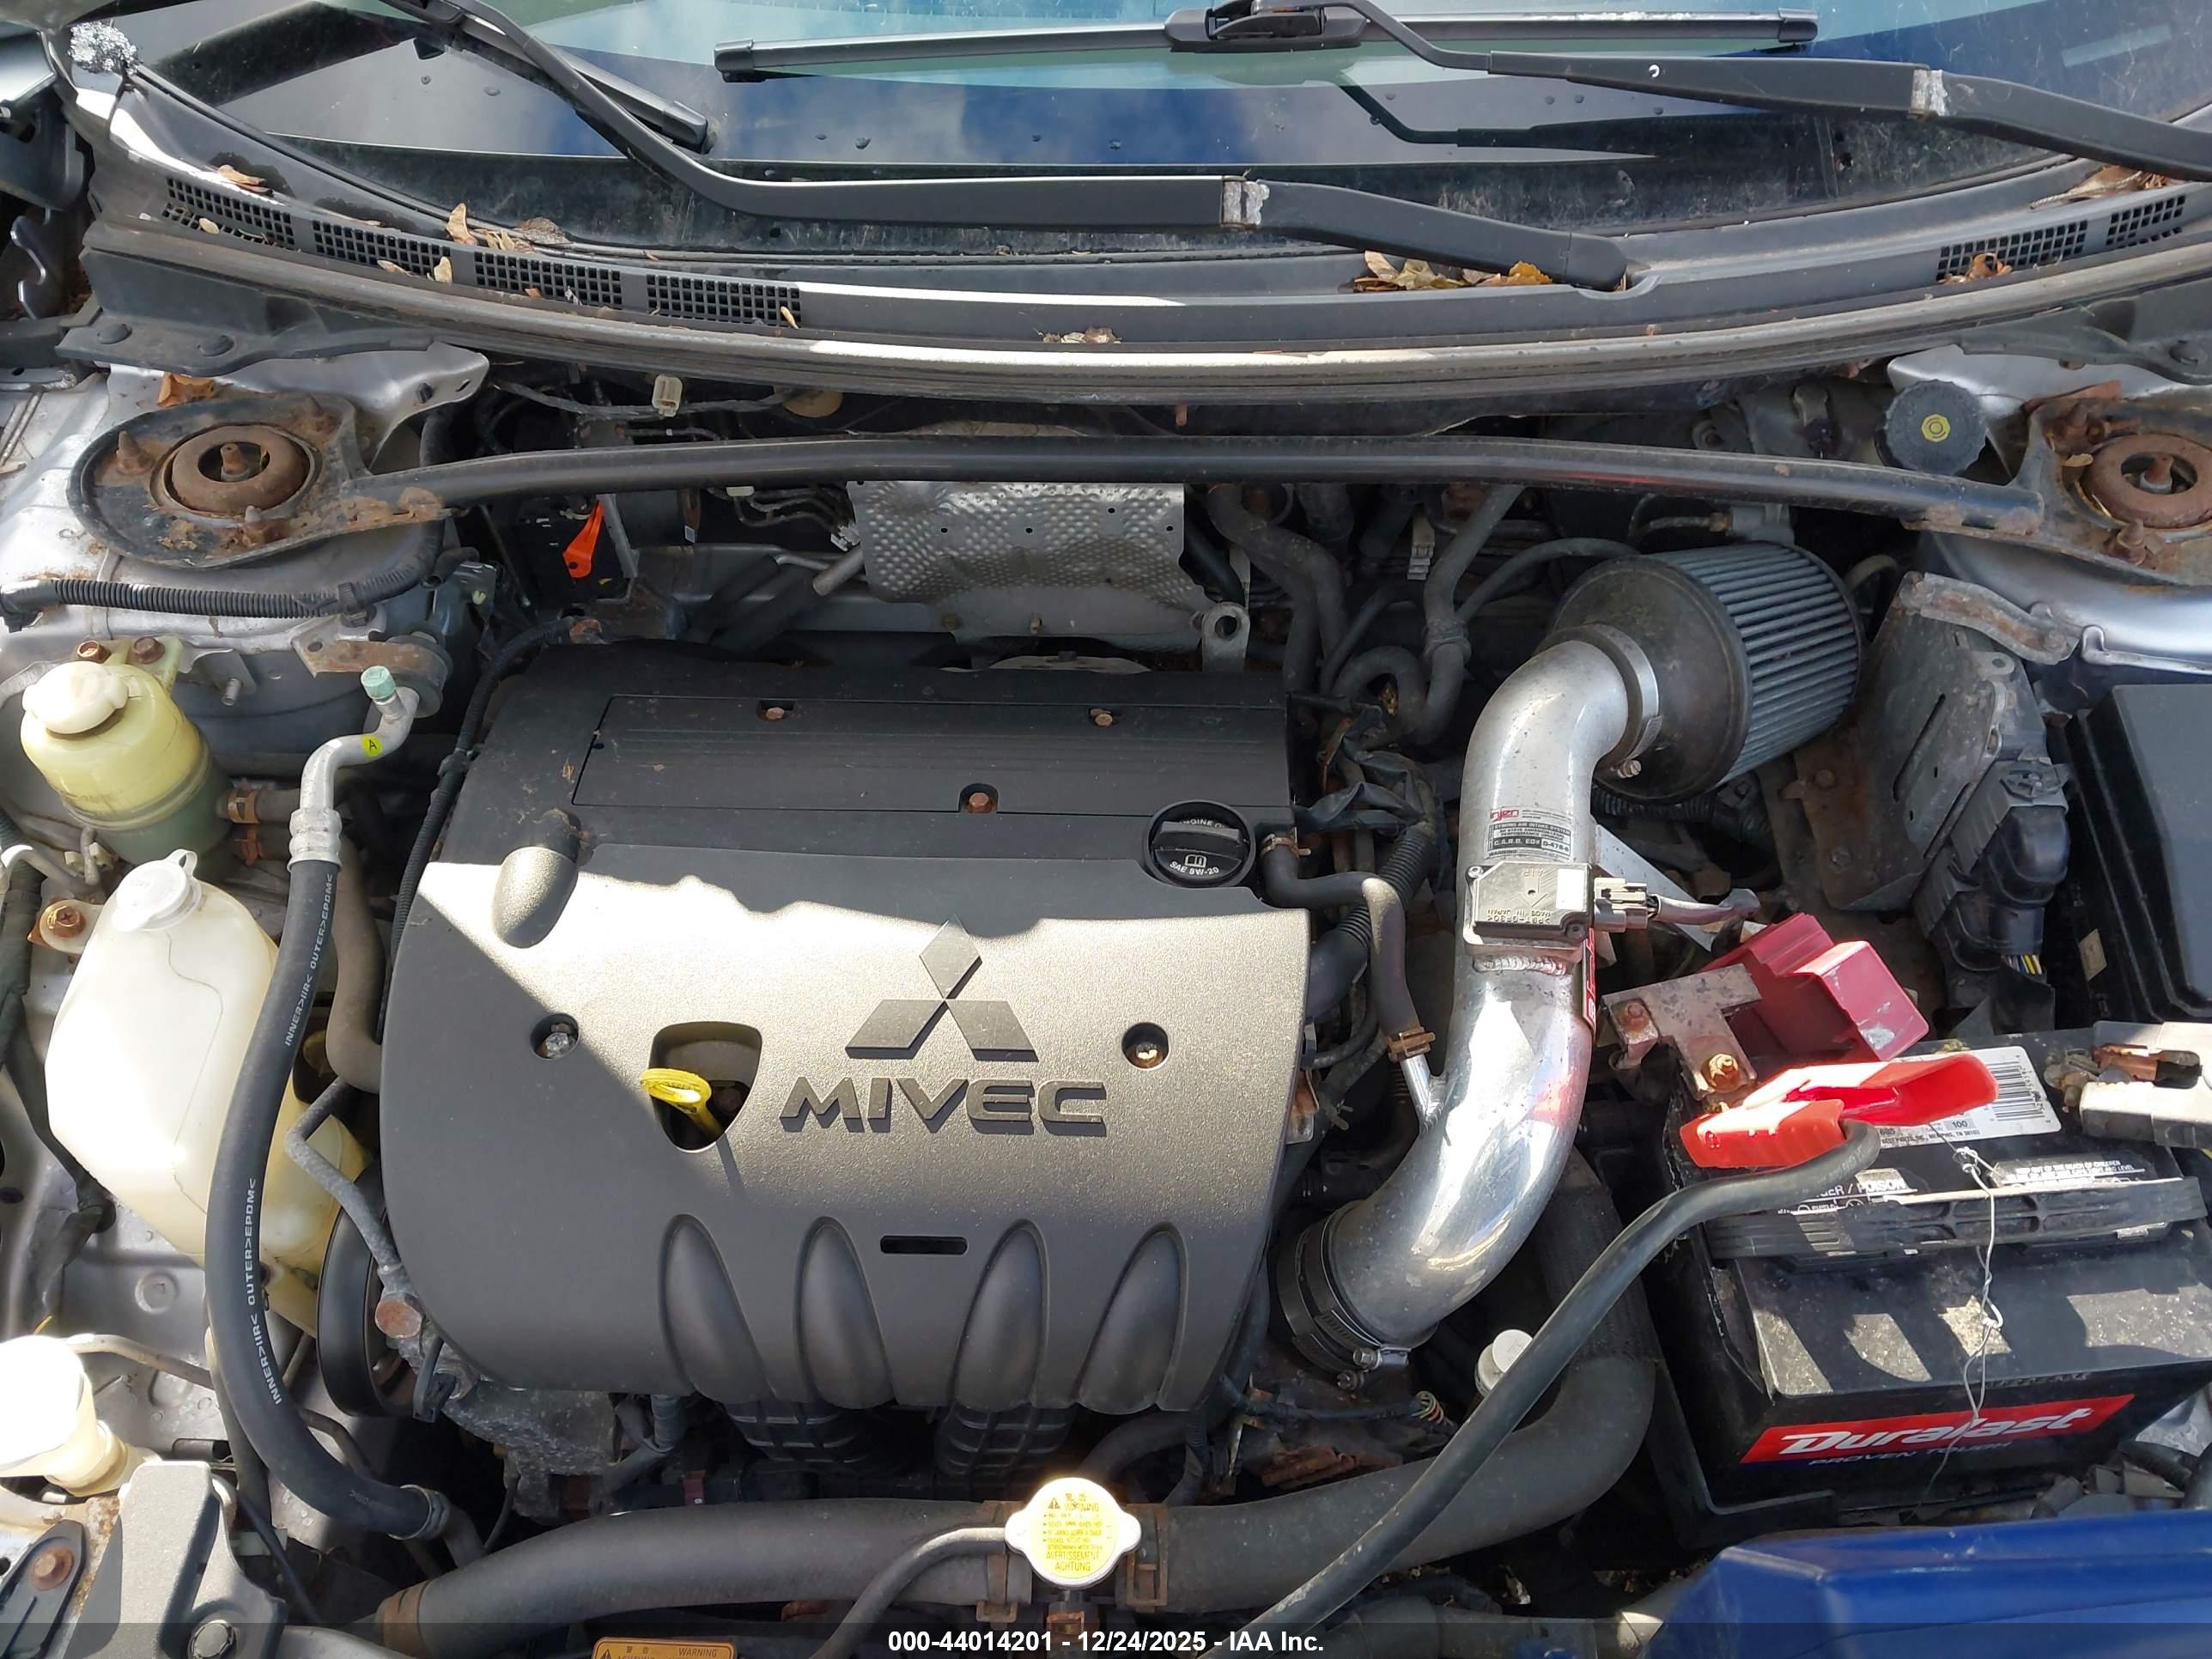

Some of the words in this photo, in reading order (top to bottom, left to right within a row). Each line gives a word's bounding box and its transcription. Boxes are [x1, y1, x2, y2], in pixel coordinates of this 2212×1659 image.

[369, 739, 377, 751] A
[1170, 861, 1188, 873] SAE
[1189, 866, 1219, 876] 5W-20
[779, 1076, 1106, 1136] MIVEC
[1858, 1179, 1909, 1193] POISON
[1779, 1407, 2093, 1455] Duralast
[1809, 1449, 1917, 1465] PROVEN
[1047, 1551, 1100, 1560] AVERTISSEMENT
[1054, 1562, 1091, 1571] ACHTUNG
[678, 1648, 717, 1657] WARNING
